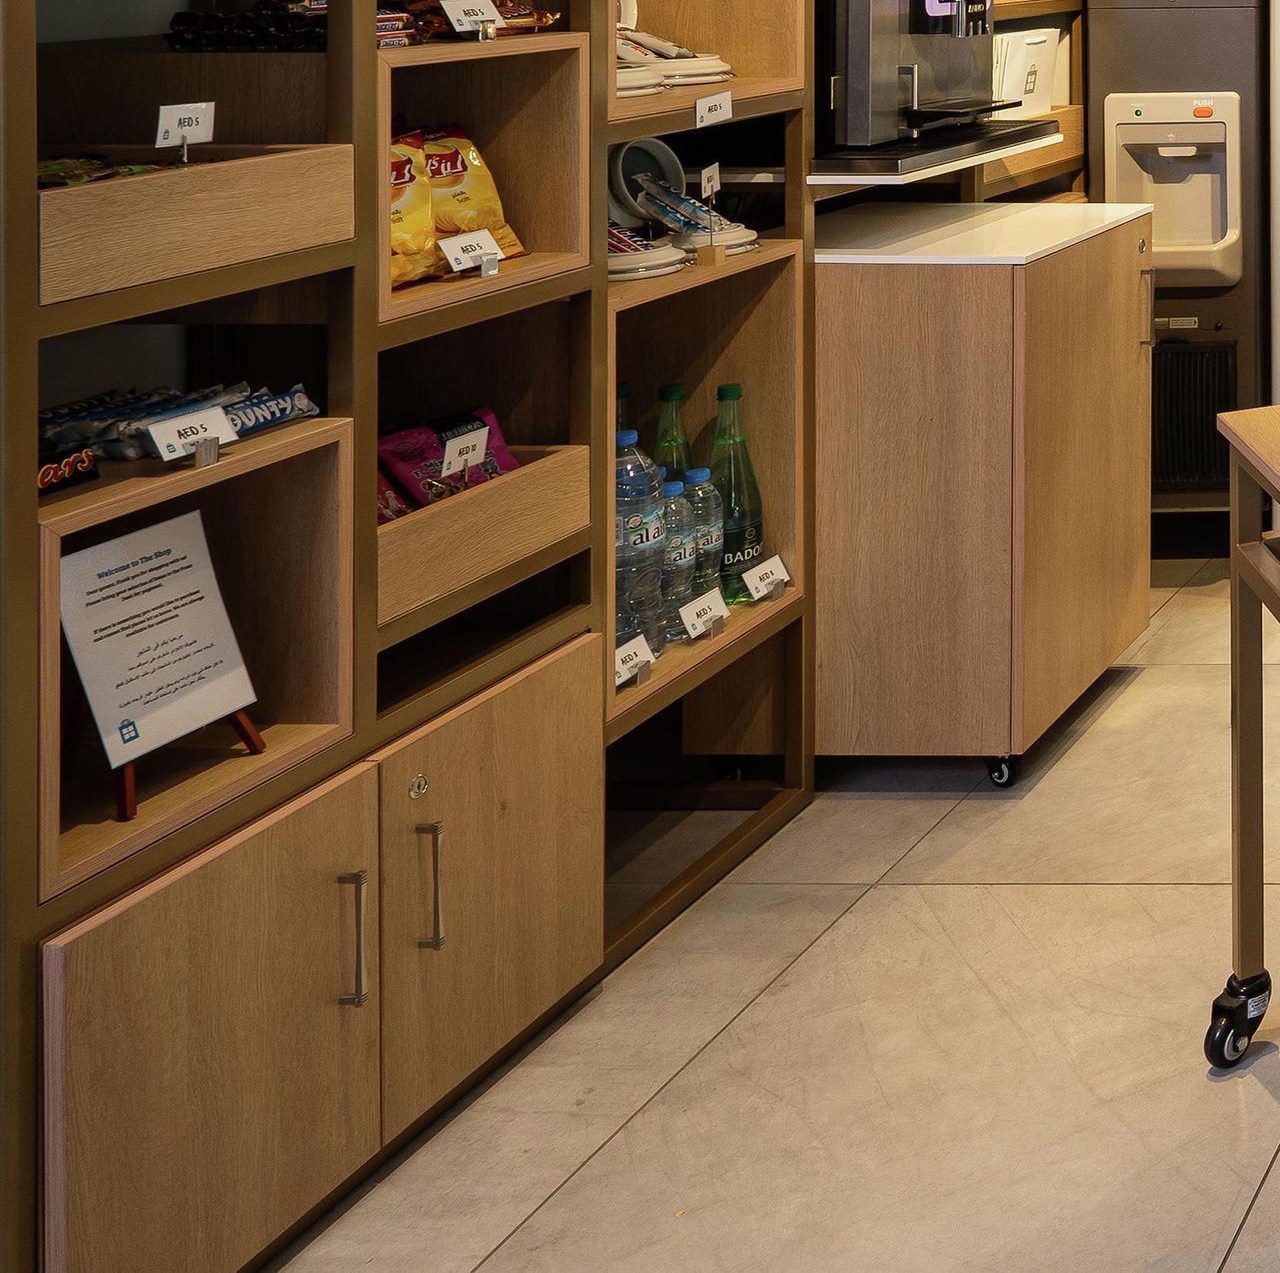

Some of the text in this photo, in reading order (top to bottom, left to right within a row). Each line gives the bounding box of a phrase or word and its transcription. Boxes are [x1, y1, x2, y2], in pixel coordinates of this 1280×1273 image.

[1193, 99, 1214, 107] PUSH
[178, 119, 193, 129] AED
[460, 244, 476, 255] AED
[177, 426, 199, 439] AED
[96, 548, 173, 579] Welcome to The Shop
